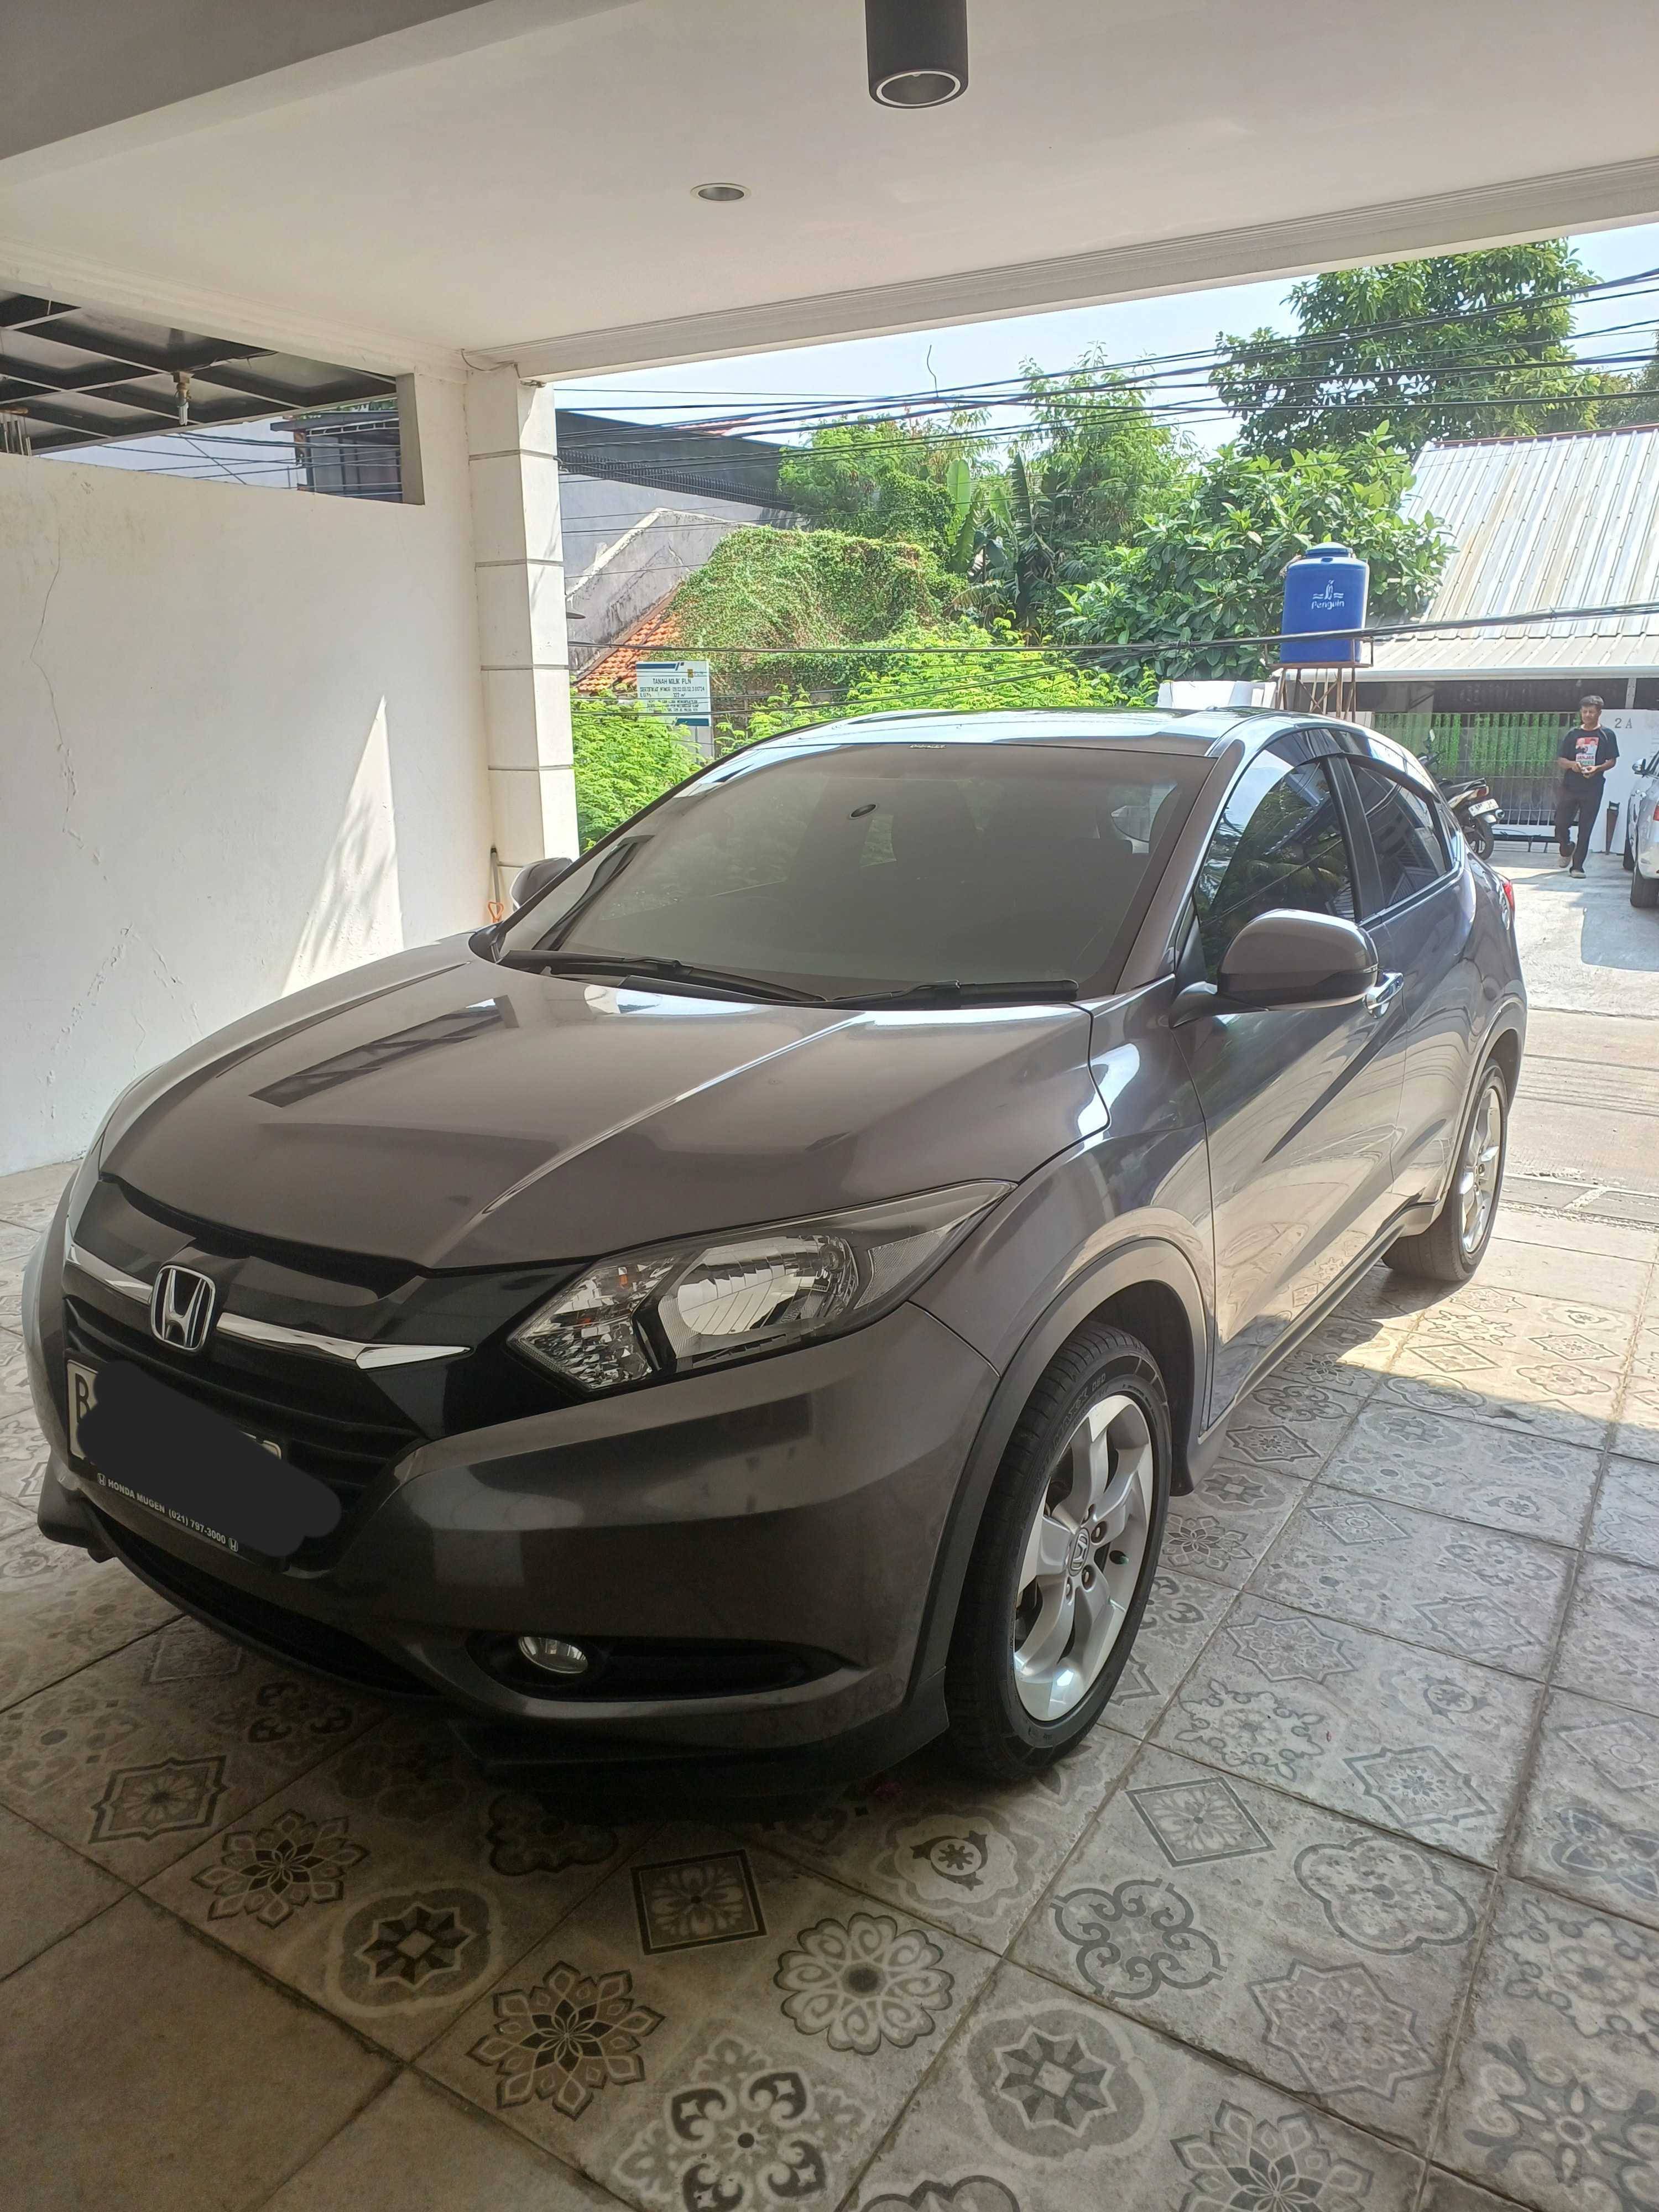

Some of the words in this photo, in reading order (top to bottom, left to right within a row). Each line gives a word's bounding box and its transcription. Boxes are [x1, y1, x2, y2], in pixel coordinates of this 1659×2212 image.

[1311, 599, 1344, 610] Penguin
[108, 1479, 135, 1499] HONDA
[137, 1493, 165, 1513] MUGEN
[169, 1509, 189, 1526] (021)
[190, 1519, 226, 1545] 797-3000
